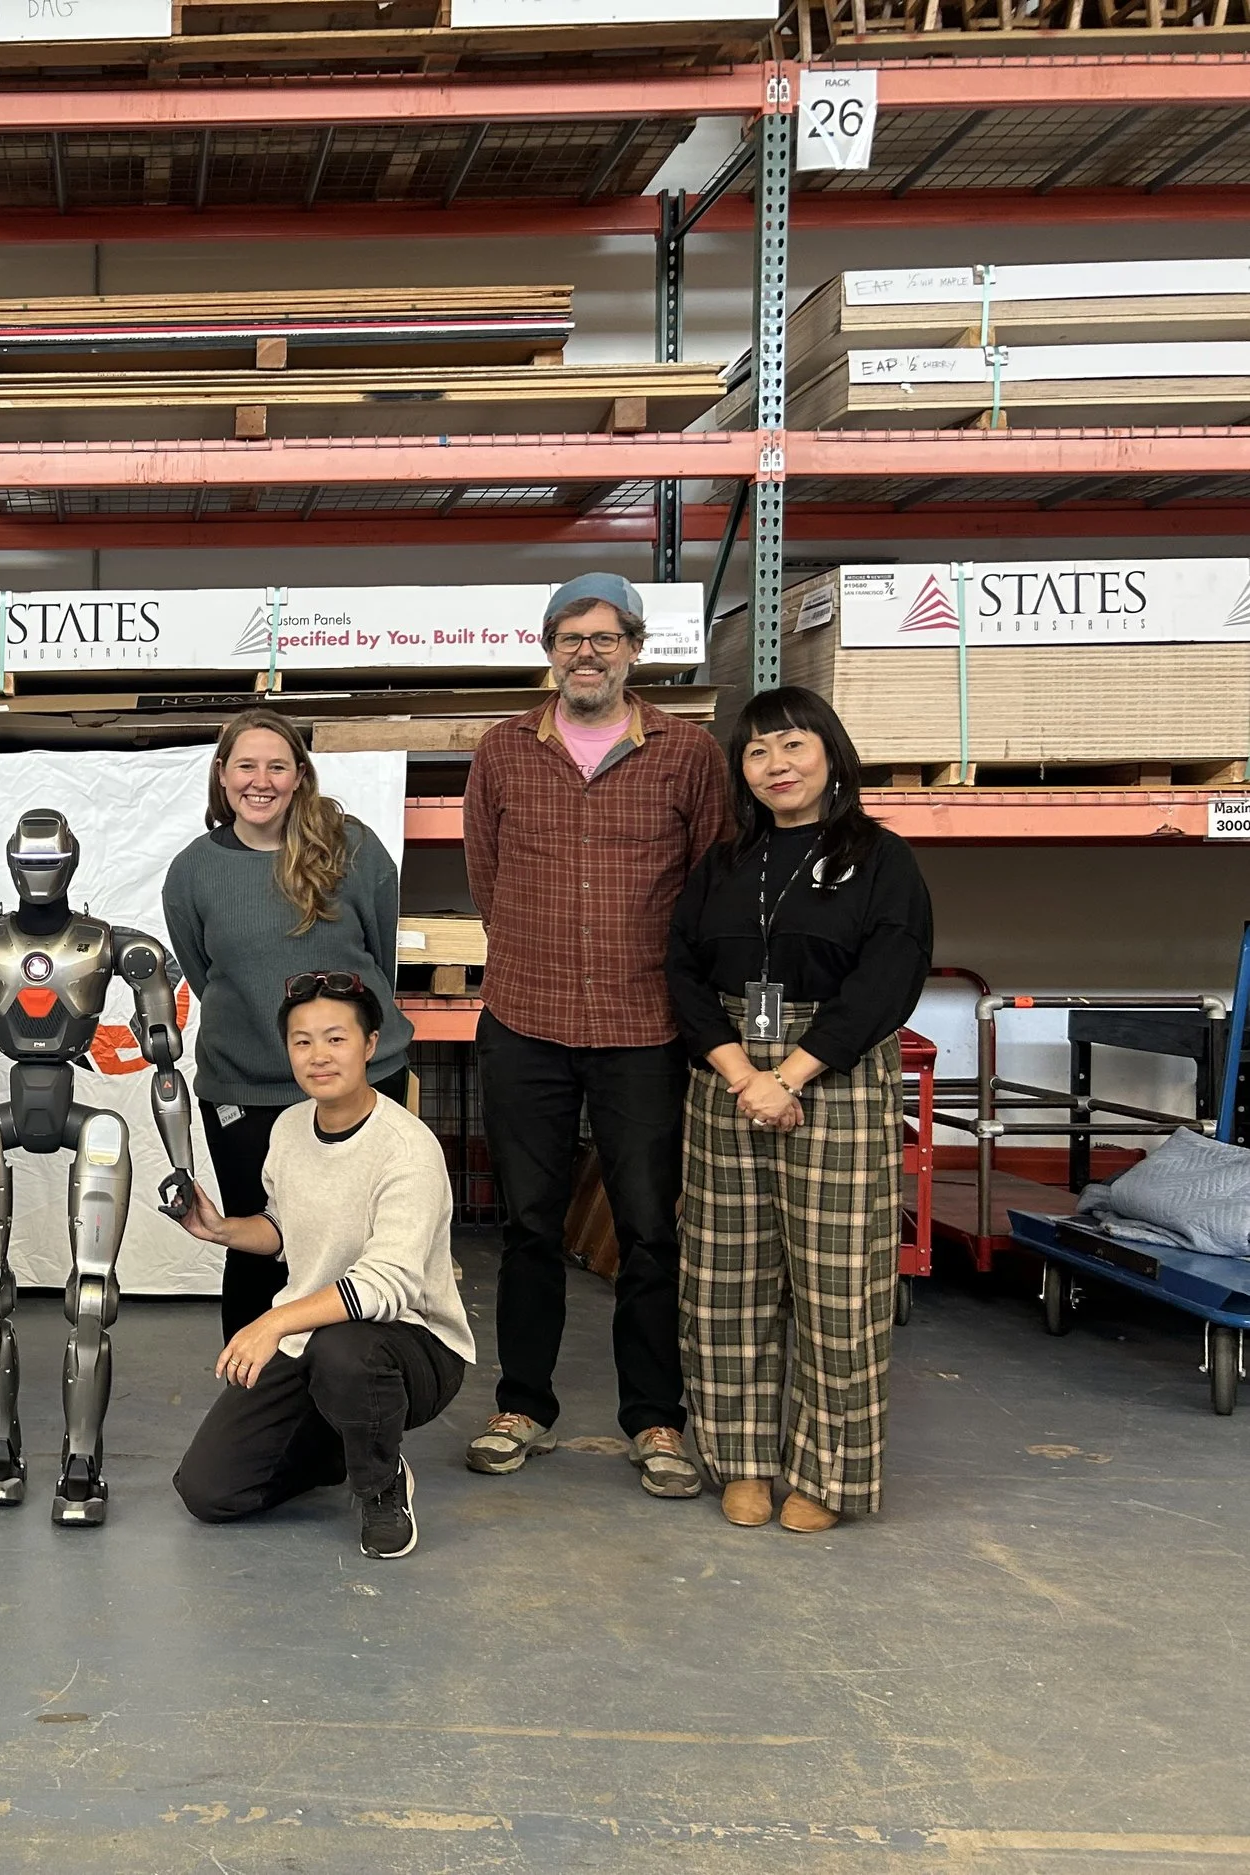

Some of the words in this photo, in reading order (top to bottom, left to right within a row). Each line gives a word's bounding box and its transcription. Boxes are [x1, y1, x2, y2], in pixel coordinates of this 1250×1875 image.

[28, 0, 79, 19] BAG
[825, 79, 850, 87] RACK
[807, 98, 864, 138] 26
[940, 277, 969, 288] MAPLE
[861, 357, 898, 376] EAP
[979, 571, 1147, 617] STATES
[6, 601, 161, 645] STATES
[267, 614, 309, 627] Custom
[314, 612, 351, 626] Panels
[980, 618, 1147, 633] INDUSTRIES
[356, 630, 381, 650] by
[387, 630, 426, 645] You.
[433, 629, 475, 645] Built
[481, 628, 509, 645] for
[8, 647, 158, 660] INDUSTRIES
[1216, 820, 1250, 831] 3000
